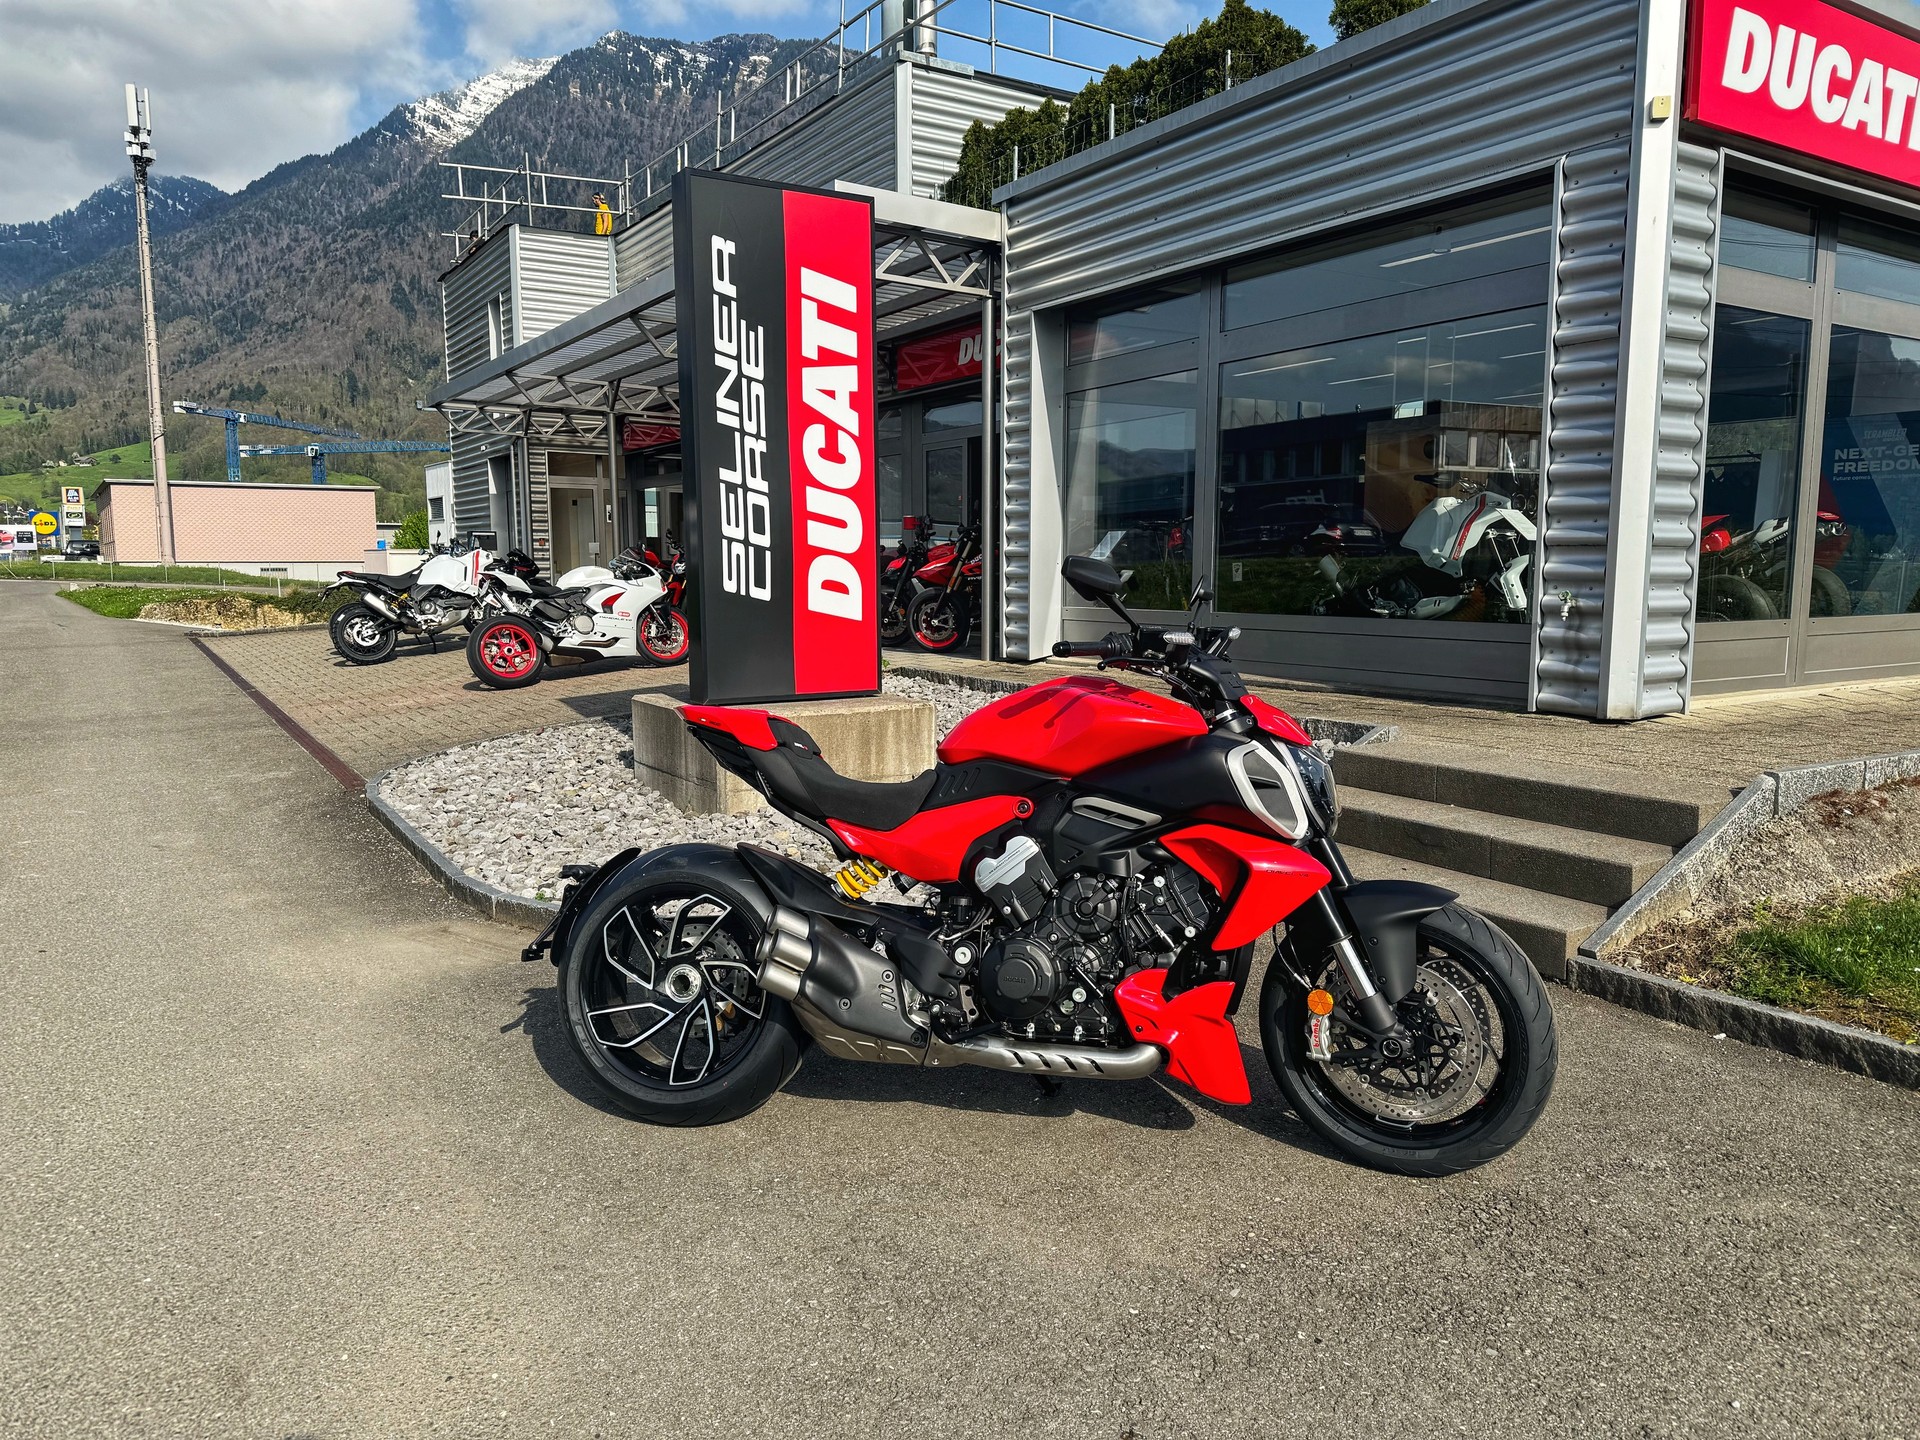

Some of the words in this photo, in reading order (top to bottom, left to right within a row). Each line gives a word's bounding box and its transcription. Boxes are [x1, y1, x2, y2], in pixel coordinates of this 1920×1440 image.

[711, 234, 746, 596] SELINER
[740, 318, 772, 602] CORSE
[800, 266, 863, 622] DUCATI
[1312, 1018, 1321, 1049] brembo
